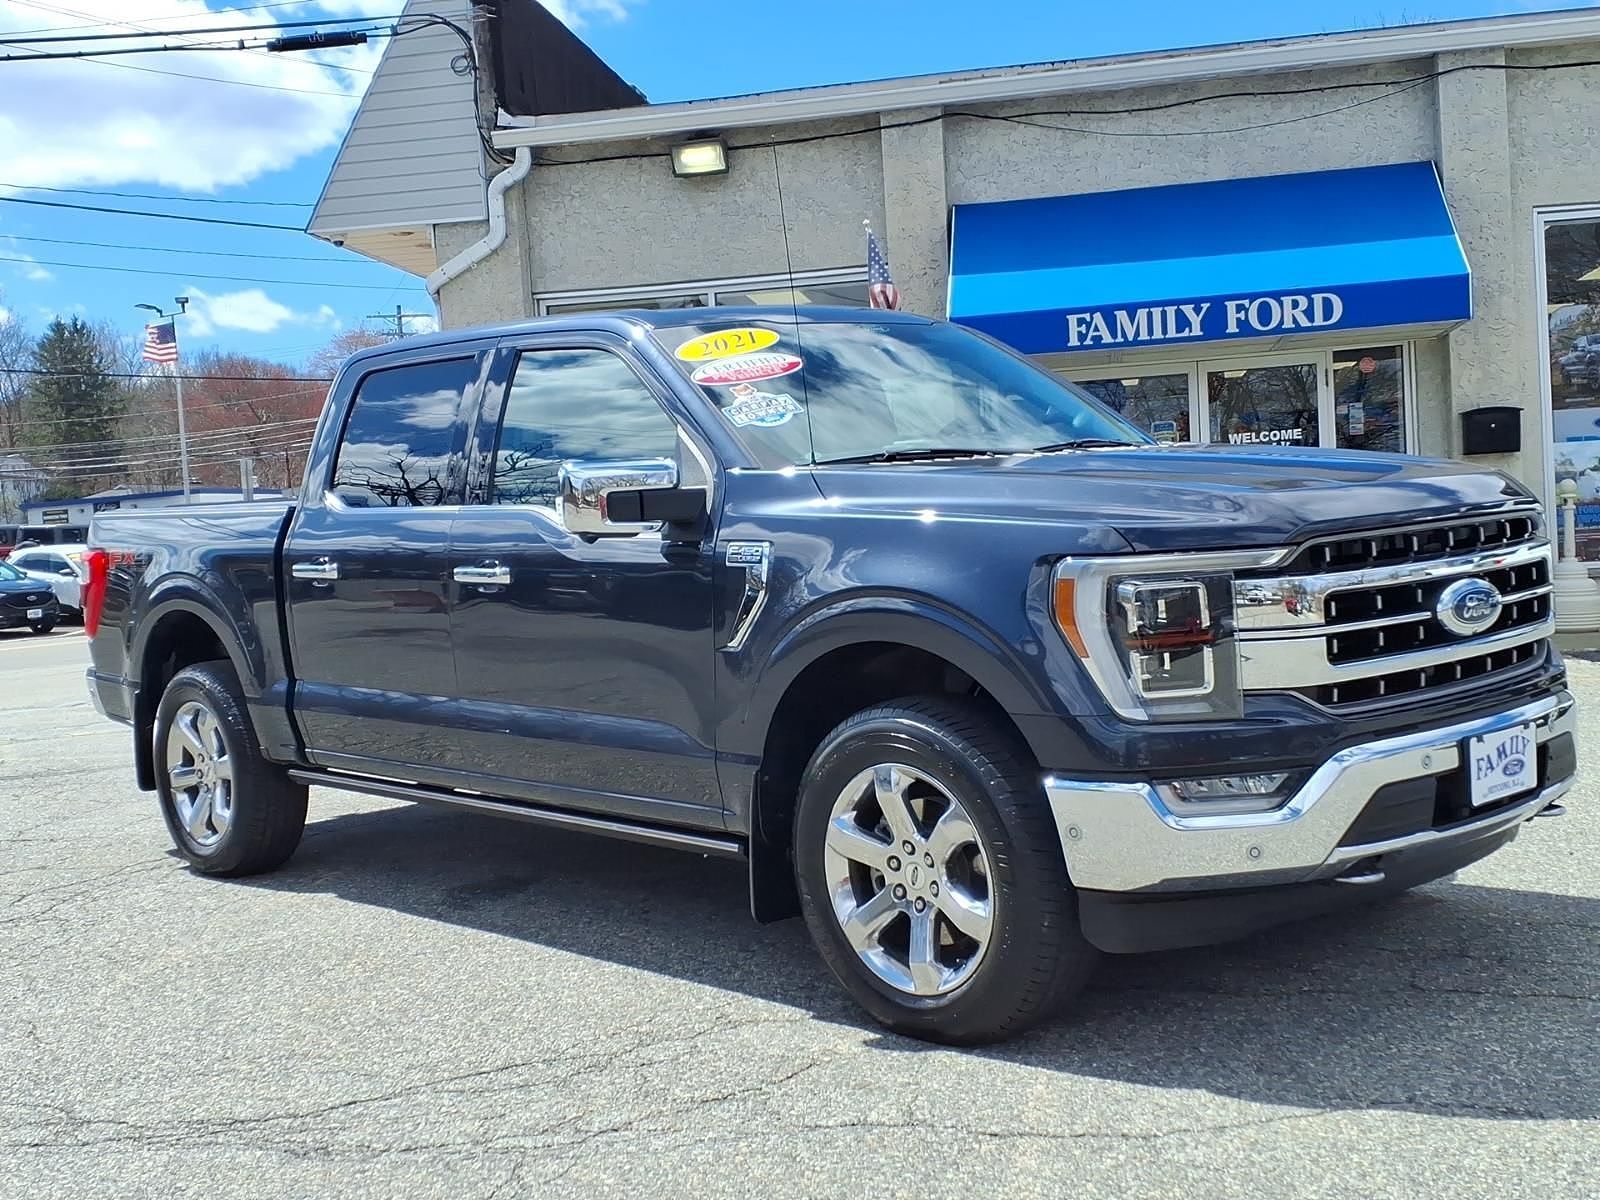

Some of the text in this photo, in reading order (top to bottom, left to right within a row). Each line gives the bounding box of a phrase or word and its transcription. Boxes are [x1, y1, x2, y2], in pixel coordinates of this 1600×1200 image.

[1066, 292, 1344, 346] FAMILY FORD
[701, 331, 756, 356] 2021
[1228, 428, 1303, 445] WELCOME
[1475, 735, 1530, 781] FAMILY
